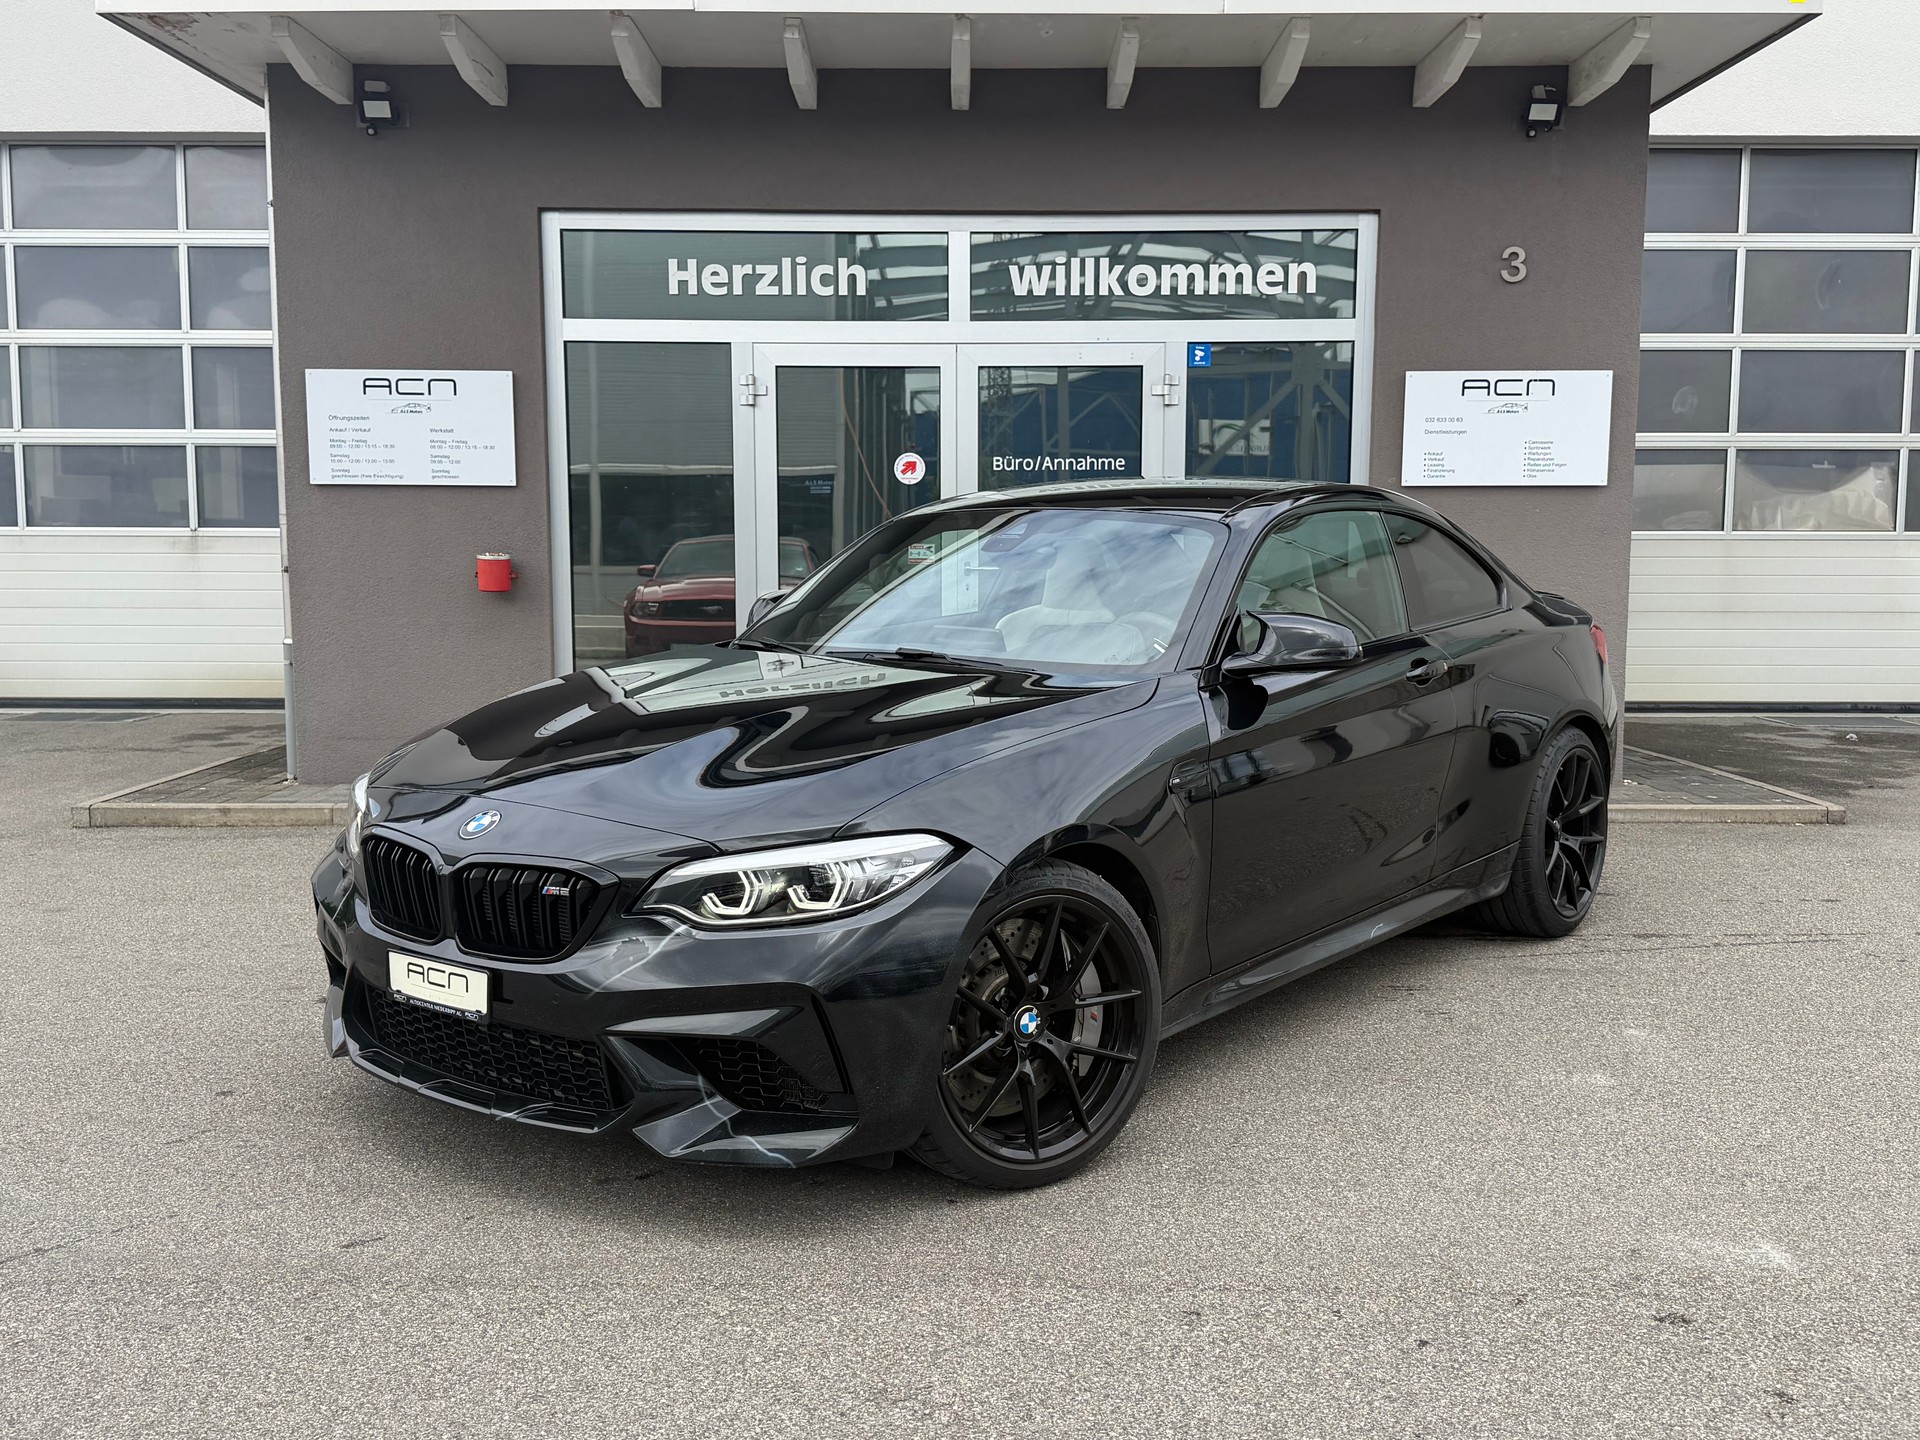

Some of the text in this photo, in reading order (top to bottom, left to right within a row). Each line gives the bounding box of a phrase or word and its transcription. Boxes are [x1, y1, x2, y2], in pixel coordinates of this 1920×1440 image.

[667, 256, 1317, 296] Herzlich willkommen
[1500, 246, 1527, 283] 3
[363, 378, 457, 396] ACN
[1461, 379, 1555, 396] ACN
[993, 456, 1125, 471] Büro/Annahme
[407, 962, 469, 993] ACN
